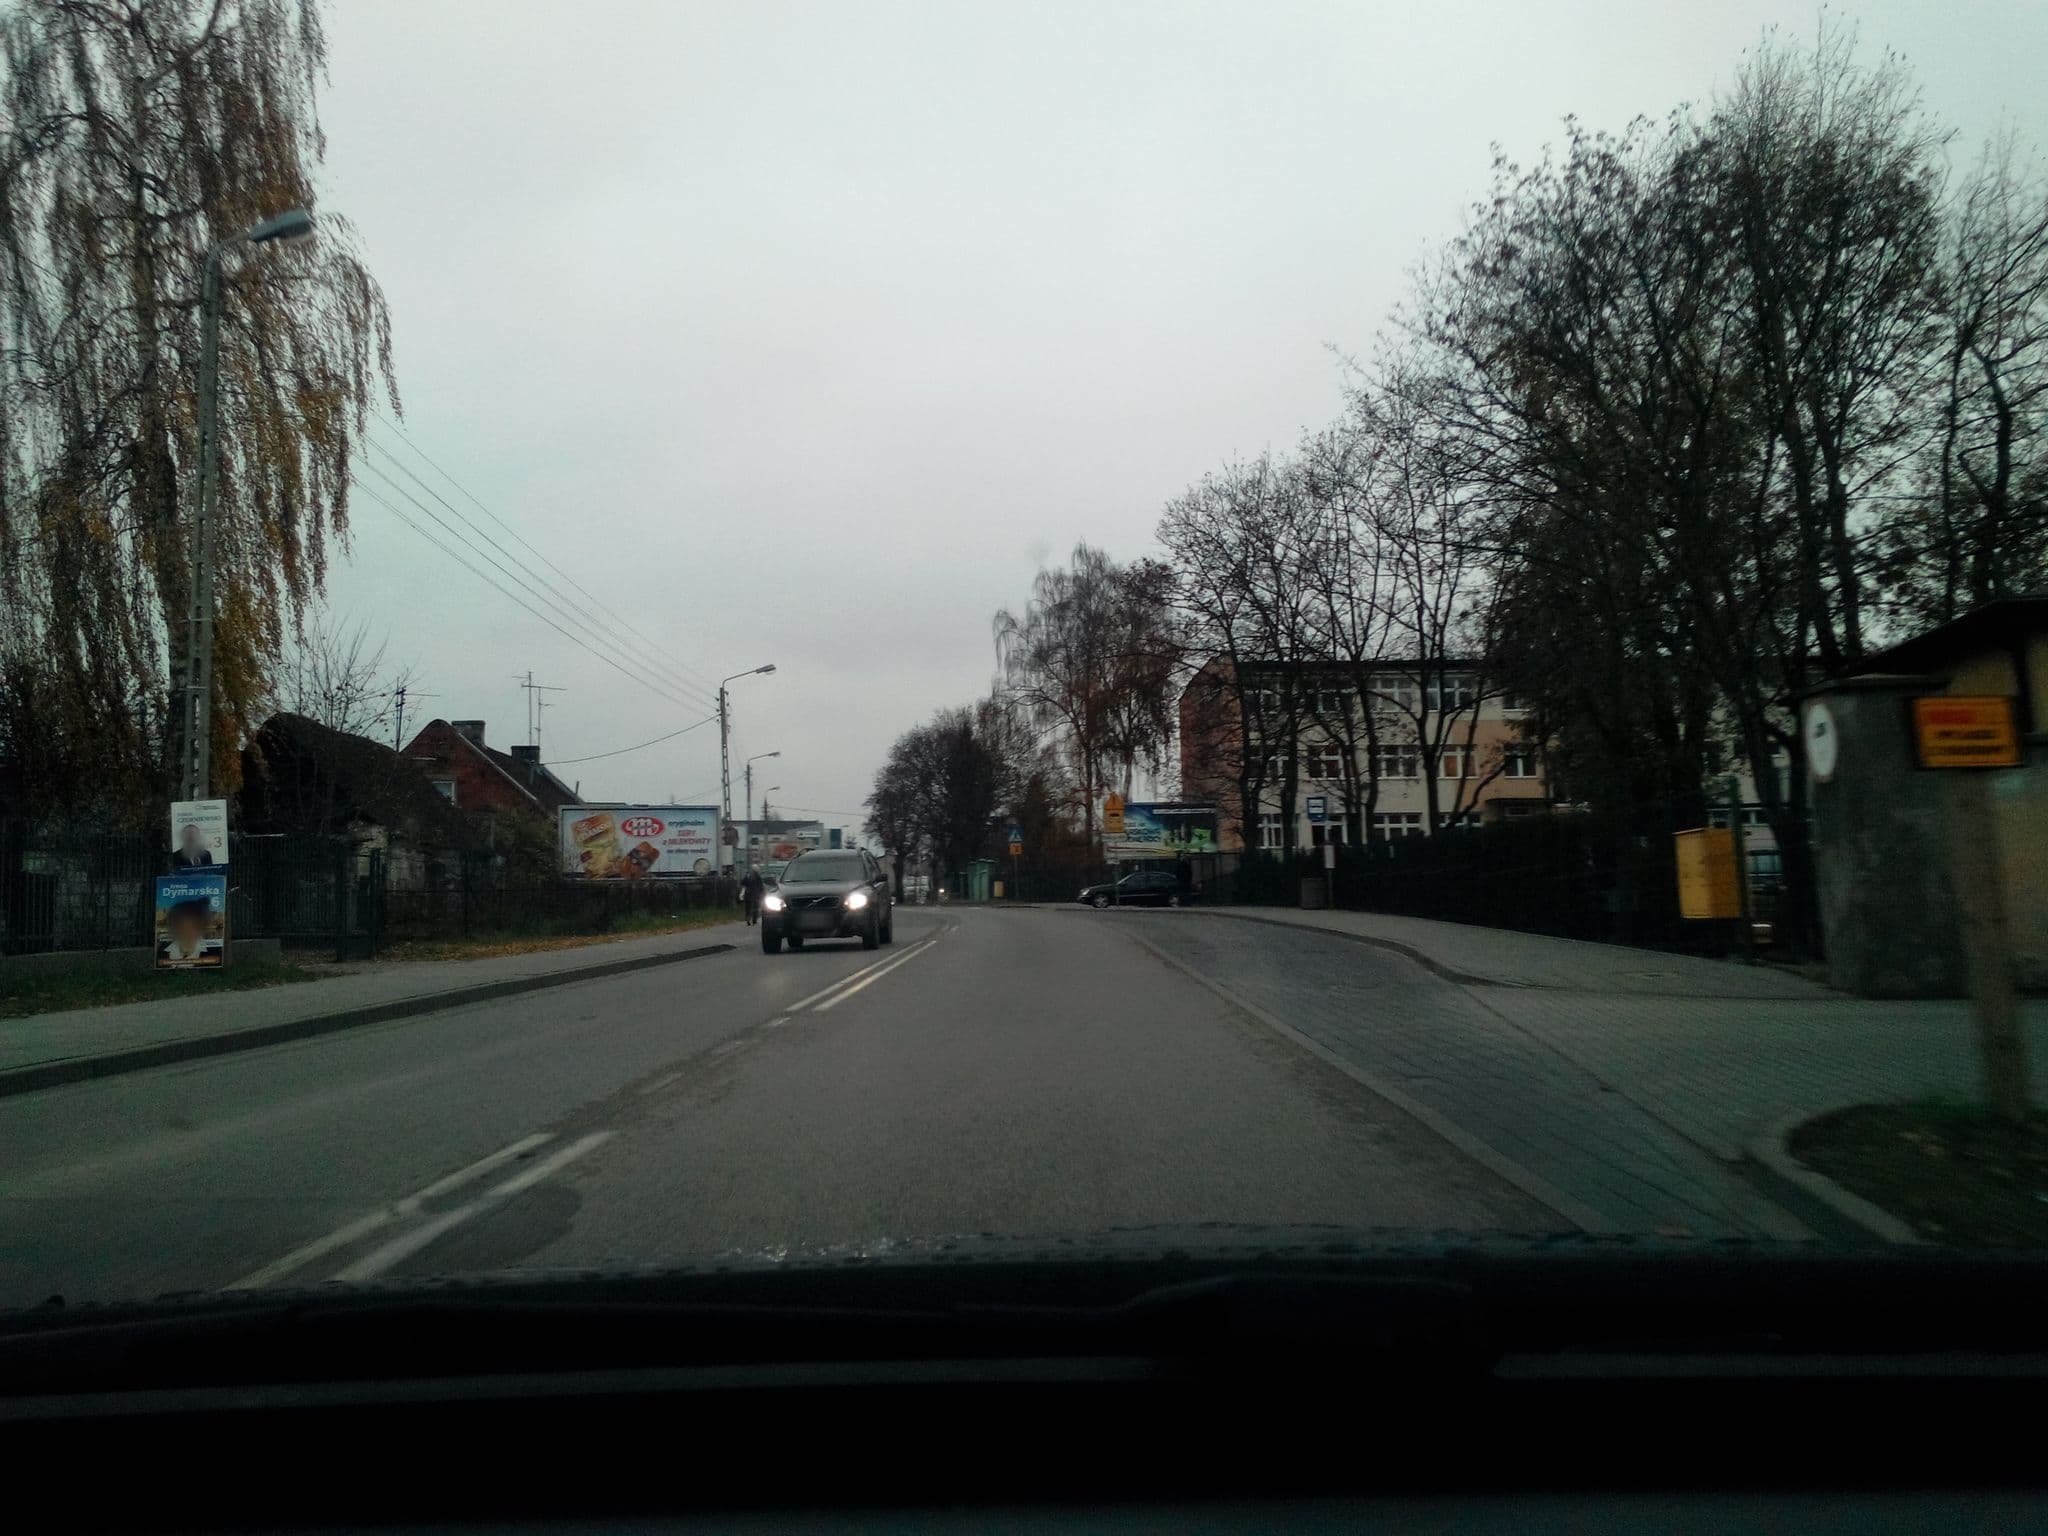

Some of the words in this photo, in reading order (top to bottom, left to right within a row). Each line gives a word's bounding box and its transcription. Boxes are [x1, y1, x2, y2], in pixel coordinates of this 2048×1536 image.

[213, 836, 222, 848] 3
[162, 887, 220, 899] Dymarska
[210, 896, 220, 907] 6
